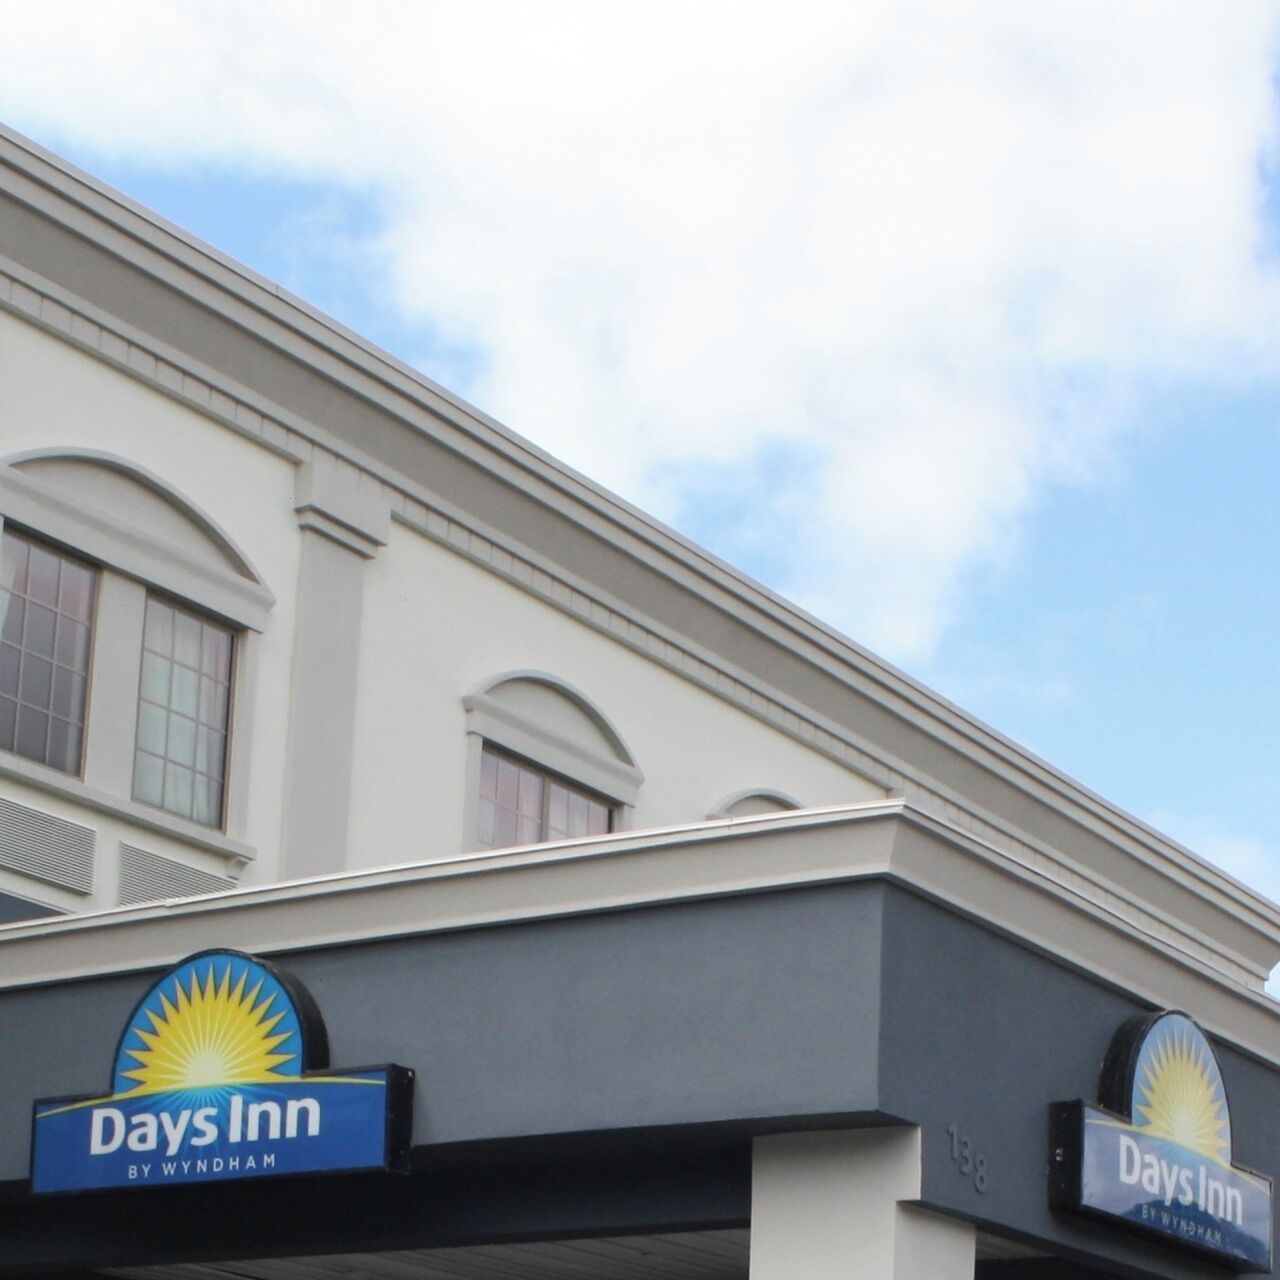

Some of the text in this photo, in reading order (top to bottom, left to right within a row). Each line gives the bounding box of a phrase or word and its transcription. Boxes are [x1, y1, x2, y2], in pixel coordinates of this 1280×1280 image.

[90, 1095, 320, 1156] Days Inn
[128, 1153, 276, 1179] BY WYNDHAM
[946, 1122, 989, 1193] 138
[1119, 1133, 1243, 1226] Days Inn
[1141, 1204, 1222, 1242] BY WYNDHAM
